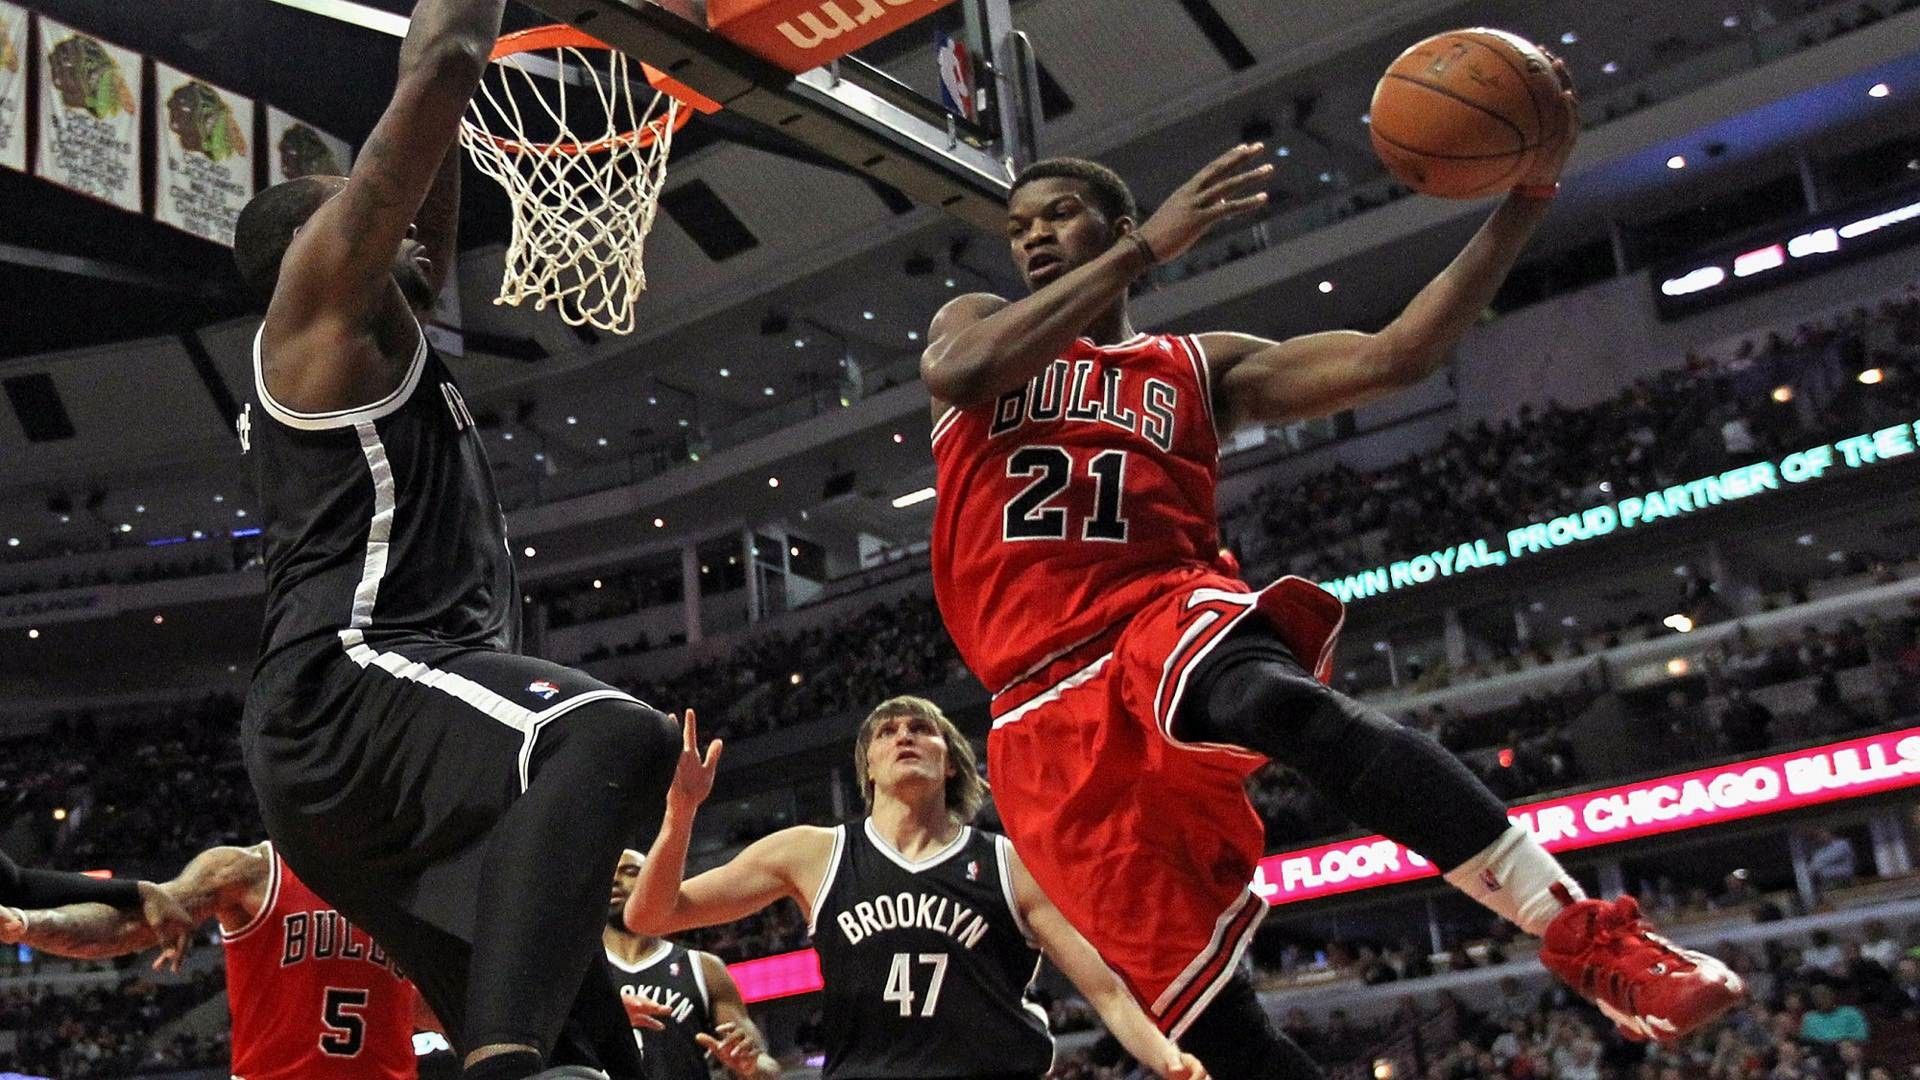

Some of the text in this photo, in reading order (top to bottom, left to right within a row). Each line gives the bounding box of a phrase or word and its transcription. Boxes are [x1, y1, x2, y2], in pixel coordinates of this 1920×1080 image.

[776, 0, 908, 48] rm
[1002, 444, 1129, 543] 21
[1506, 505, 1618, 558] PROUD
[1618, 460, 1780, 529] PARTNER
[1779, 444, 1833, 483] OF
[1834, 423, 1915, 469] THE
[1582, 765, 1780, 833] CHICAGO
[1783, 735, 1920, 796] BULLS
[1281, 839, 1401, 892] FLOOR
[280, 909, 405, 982] BULL
[836, 891, 990, 950] BROOKLYN
[620, 984, 694, 1024] OKLYN
[882, 952, 949, 1018] 47
[318, 985, 370, 1058] 5
